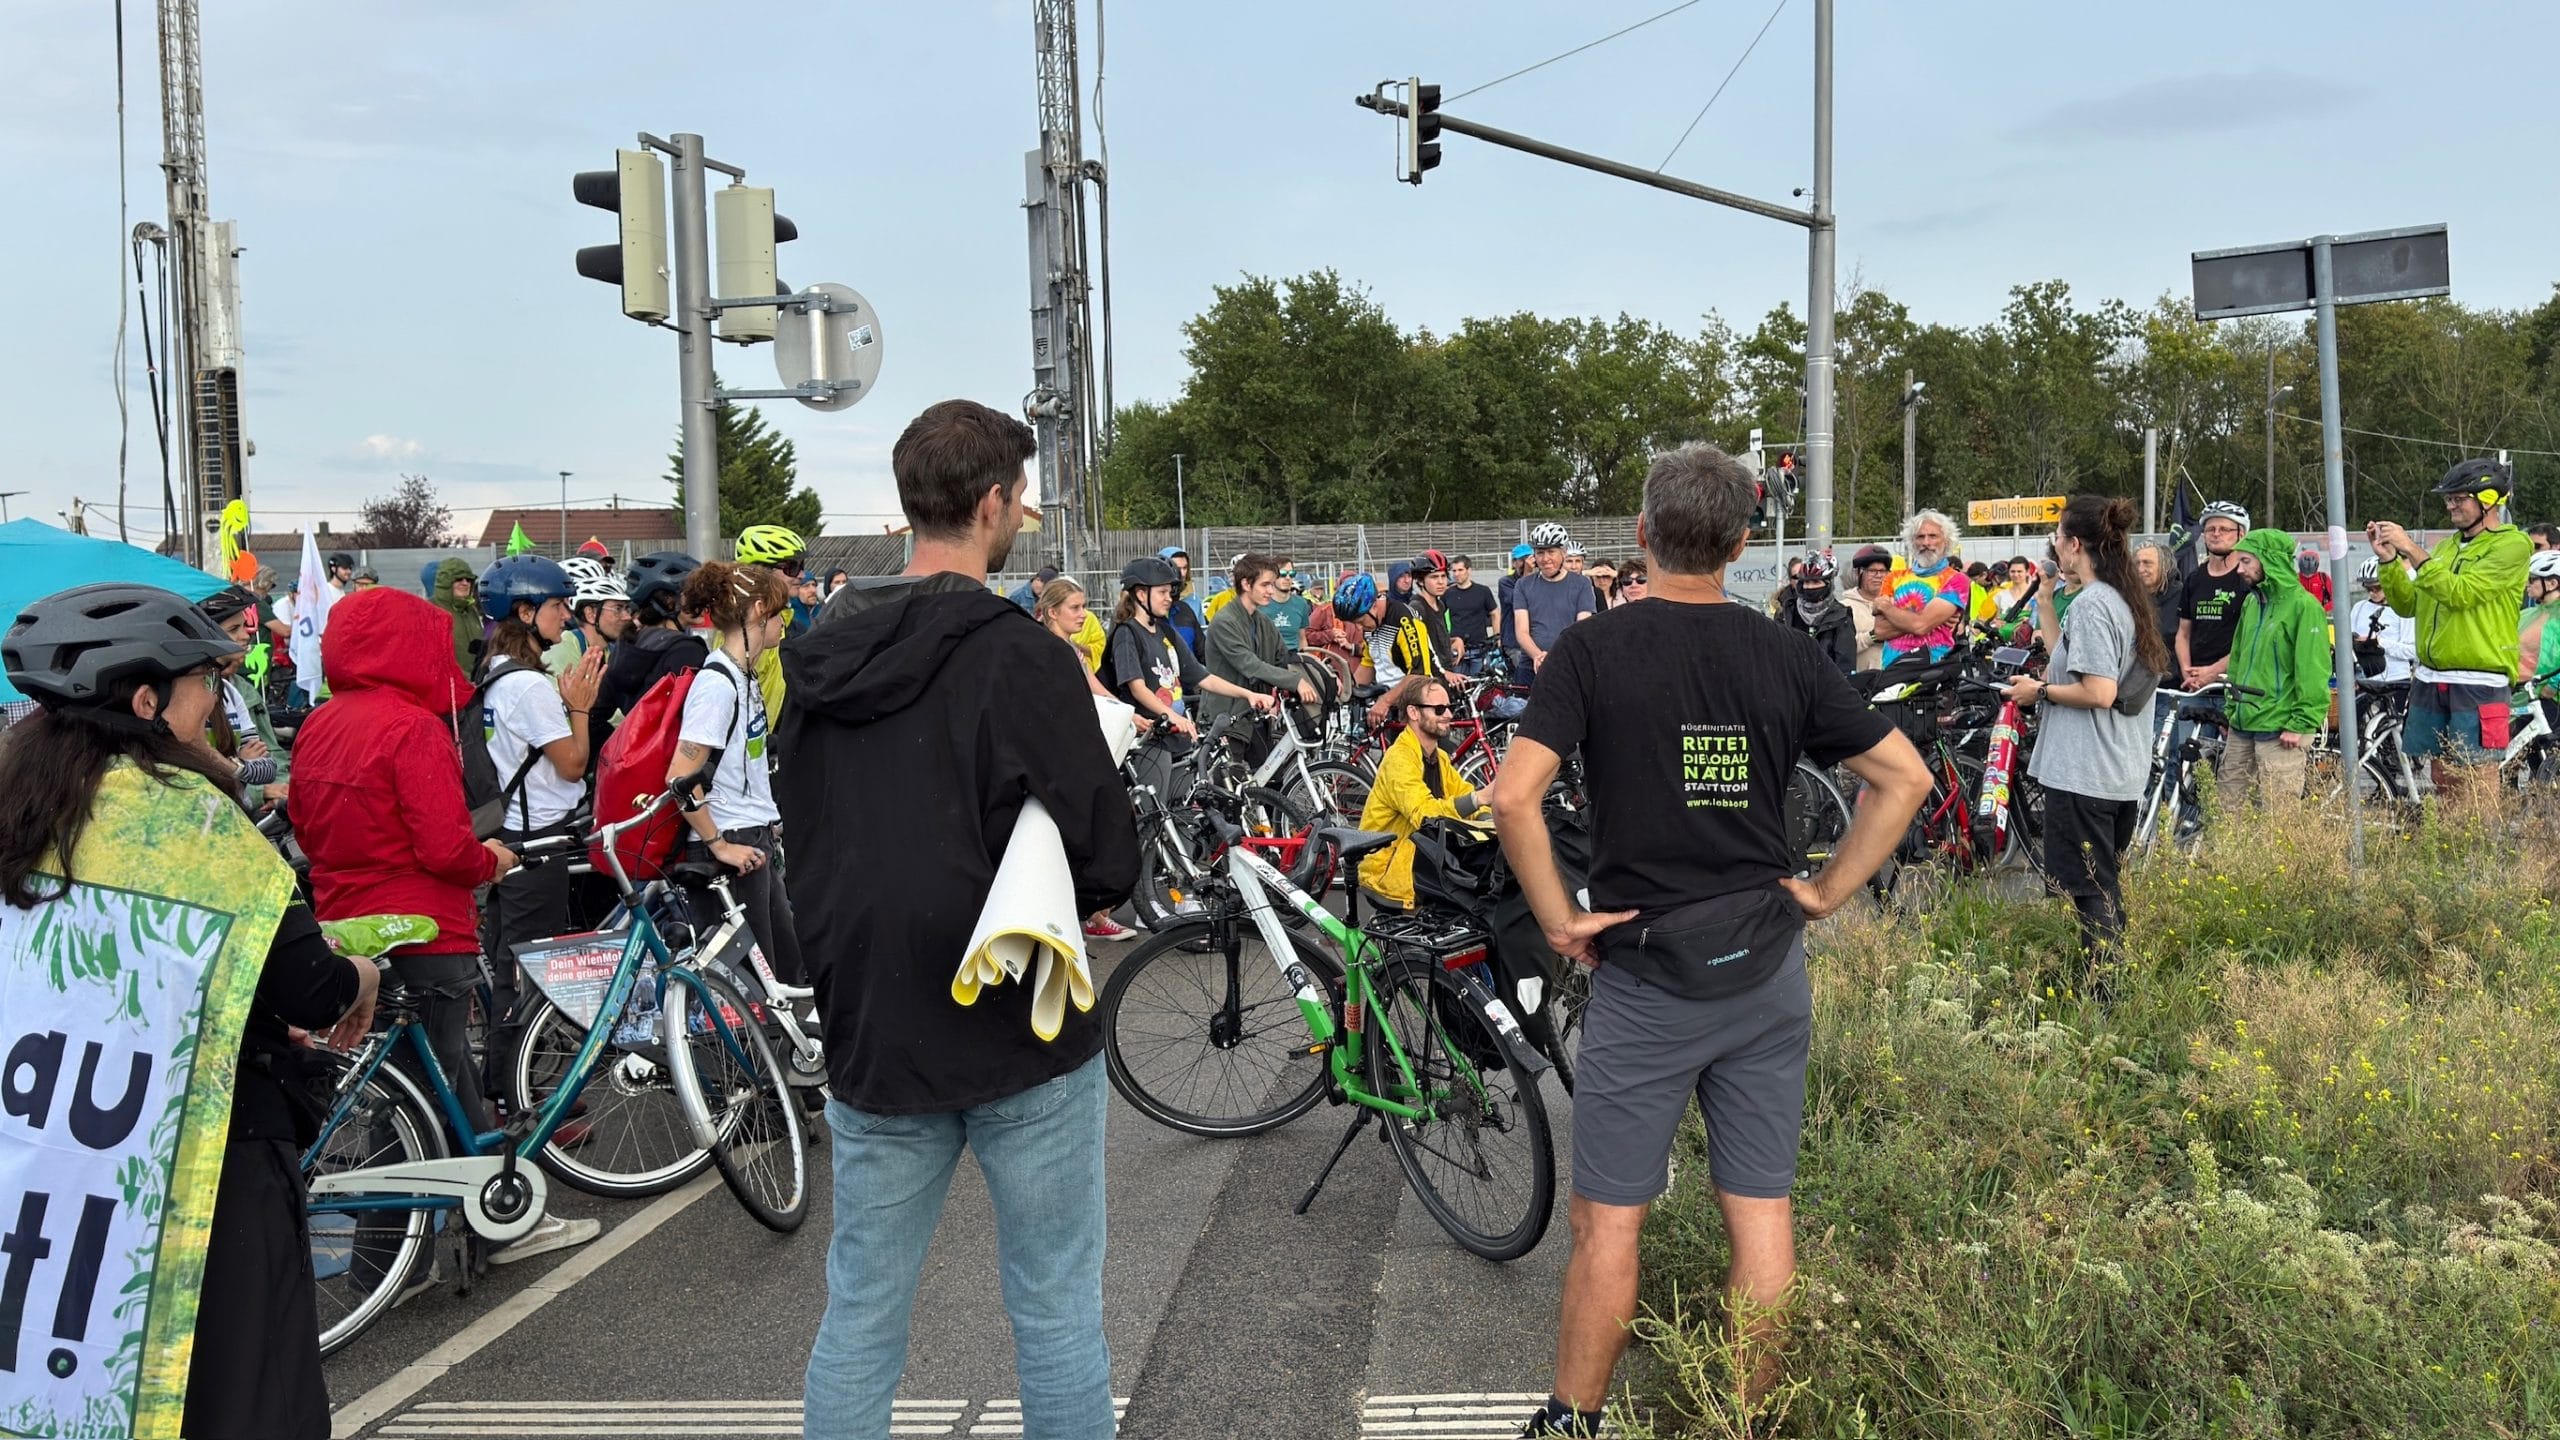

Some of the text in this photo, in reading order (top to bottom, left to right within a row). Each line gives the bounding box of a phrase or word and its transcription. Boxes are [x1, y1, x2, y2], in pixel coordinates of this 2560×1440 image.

[1991, 502, 2043, 520] Umleitung
[2196, 606, 2223, 615] KEINE
[1400, 616, 1419, 657] adidas
[1683, 754, 1706, 765] DIE
[1684, 766, 1749, 781] NATUR
[1684, 782, 1719, 792] STATT
[550, 958, 575, 970] Dein
[548, 971, 574, 982] deine
[576, 967, 610, 981] grünen
